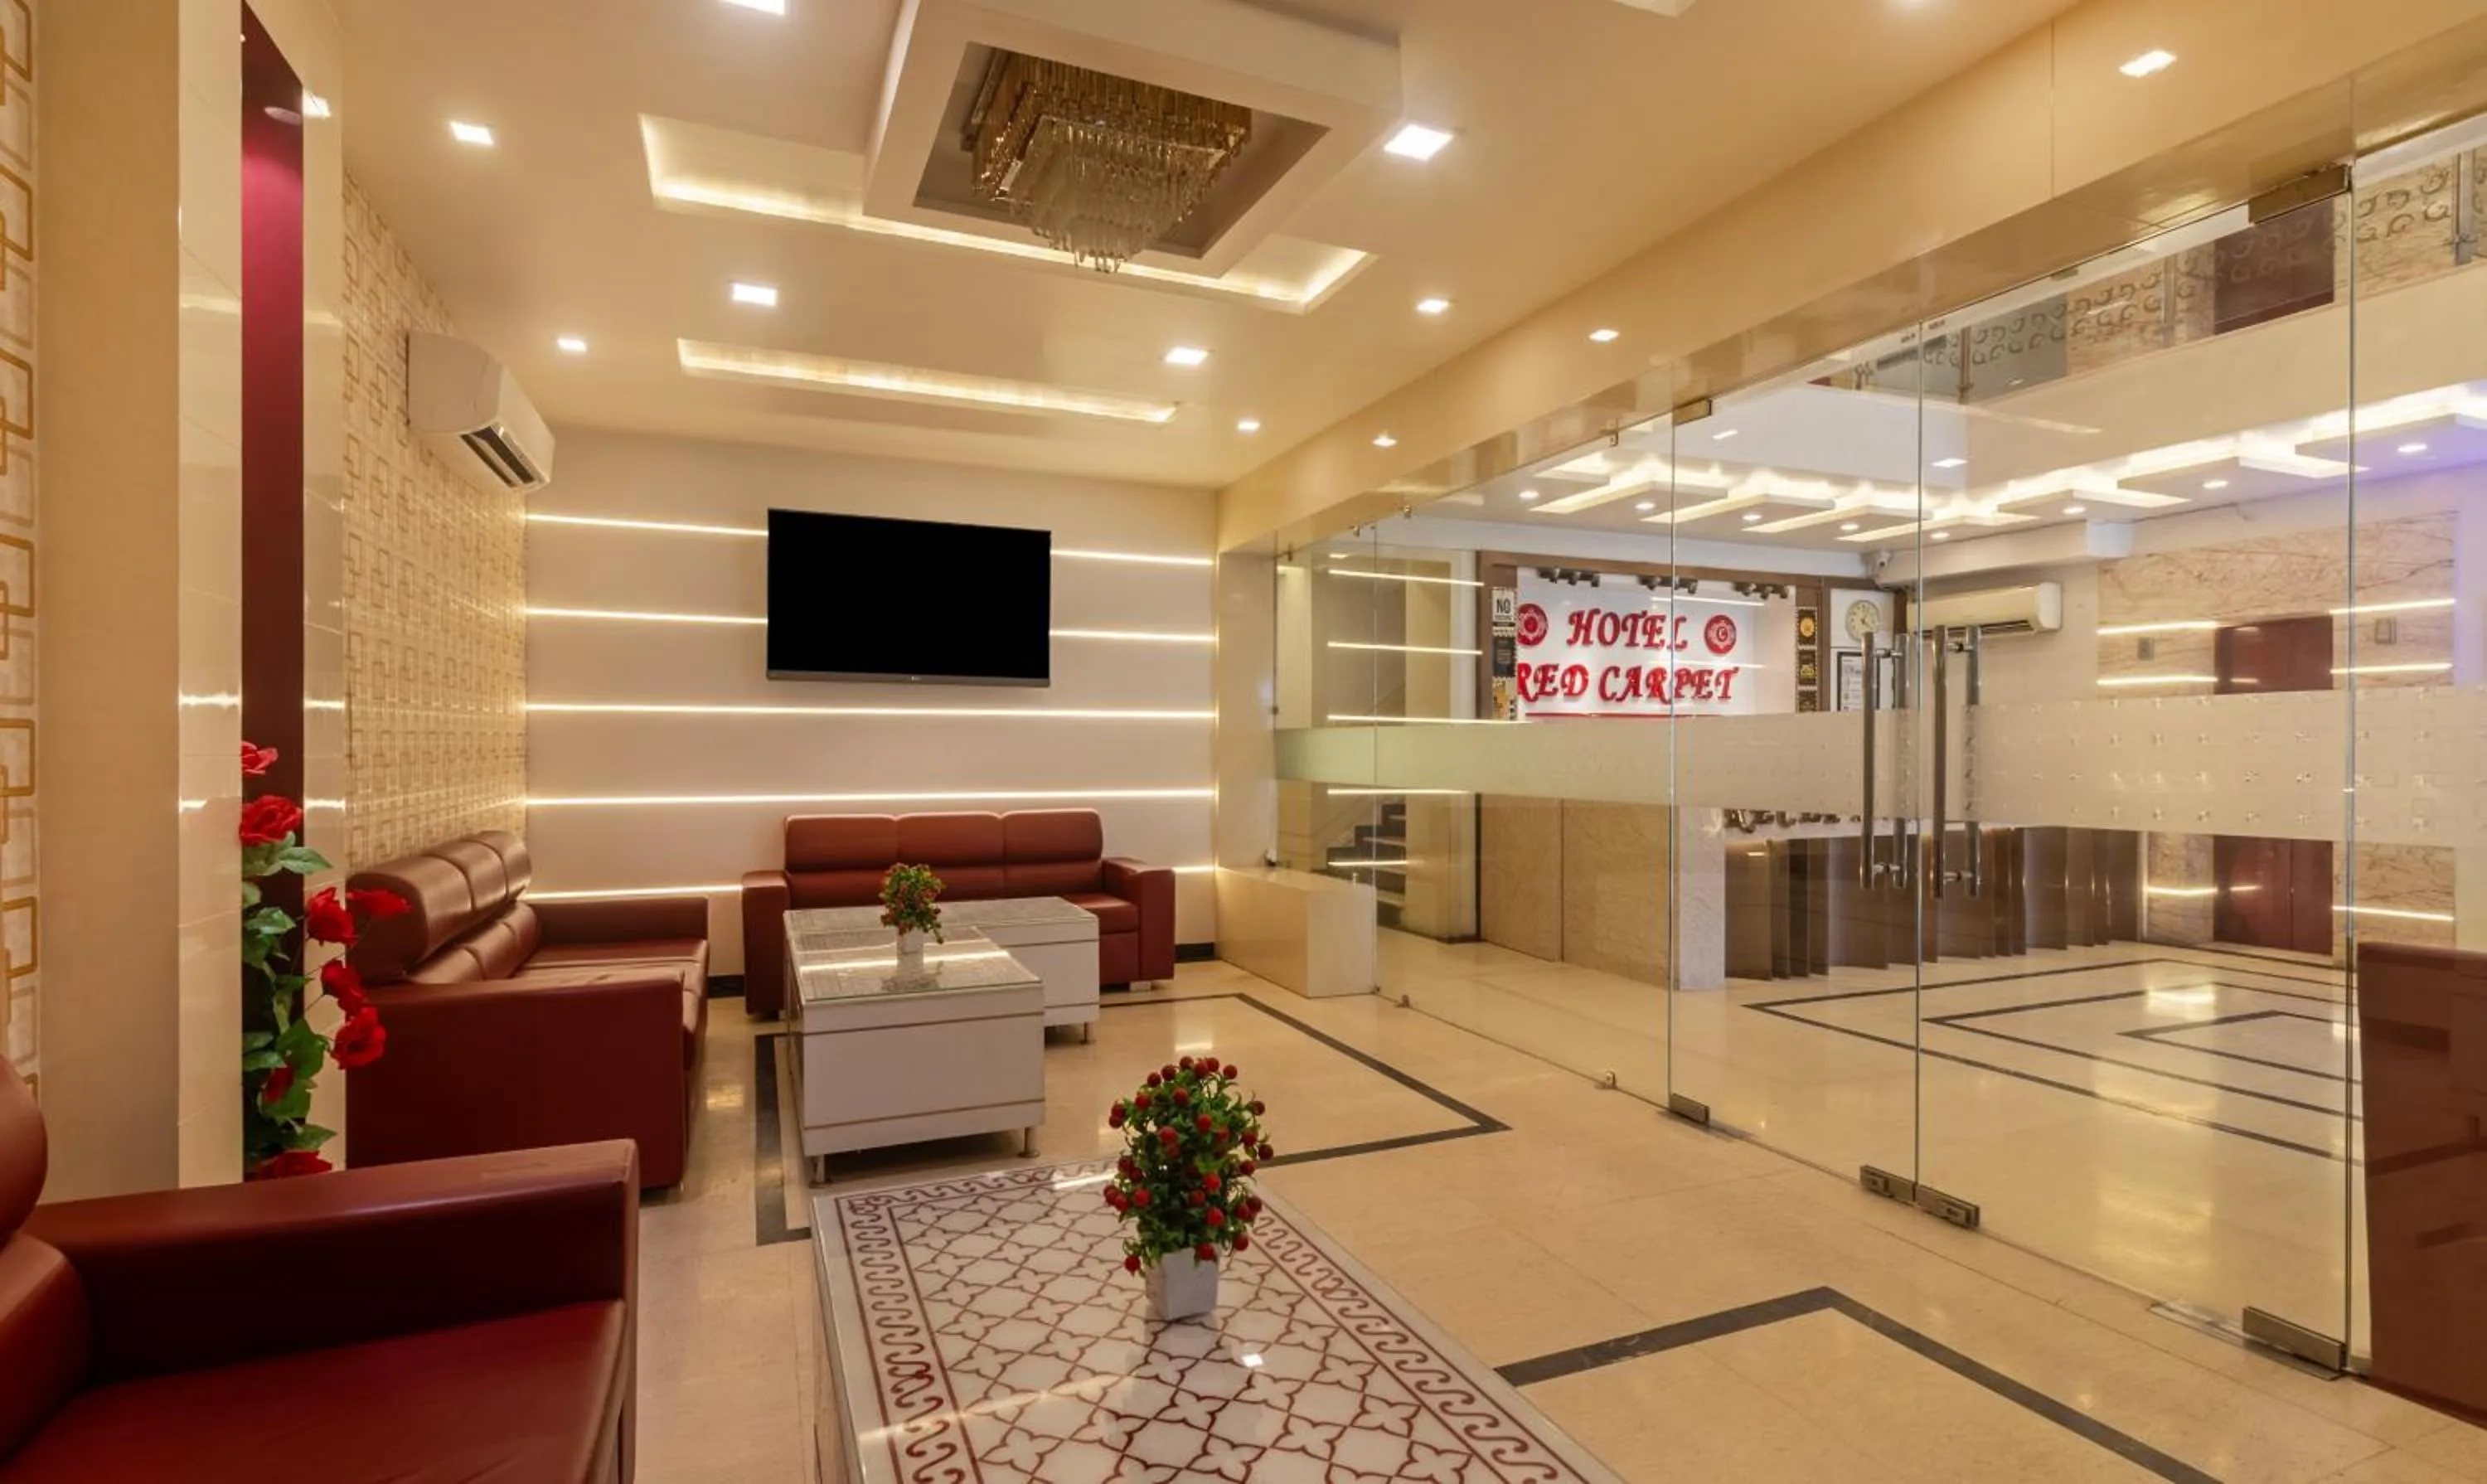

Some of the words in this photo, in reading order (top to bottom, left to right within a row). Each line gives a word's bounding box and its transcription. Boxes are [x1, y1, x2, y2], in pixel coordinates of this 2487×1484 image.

[1566, 608, 1689, 650] HOTEL
[1516, 662, 1589, 702] RED
[1597, 665, 1740, 705] CARPET
